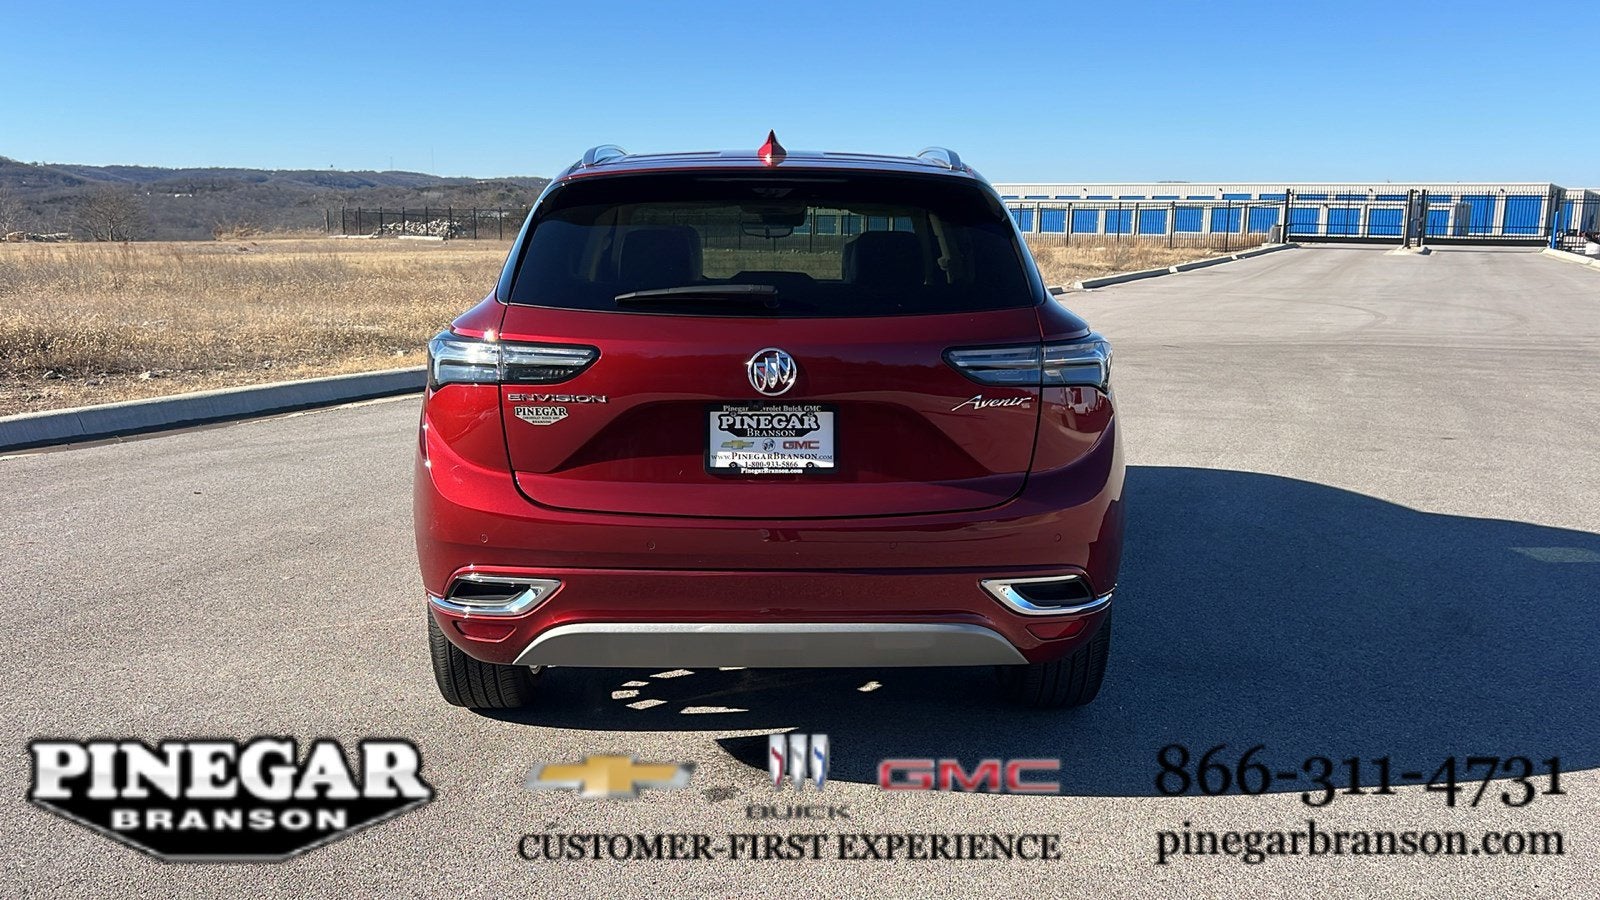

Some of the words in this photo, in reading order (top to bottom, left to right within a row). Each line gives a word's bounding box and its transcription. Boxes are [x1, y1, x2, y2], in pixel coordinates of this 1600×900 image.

[507, 393, 607, 403] ENVISION
[951, 394, 1032, 412] Avenir
[515, 407, 568, 416] PINEGAR
[723, 405, 749, 413] Pinegar
[720, 415, 818, 429] PINEGAR
[782, 441, 820, 449] GMC
